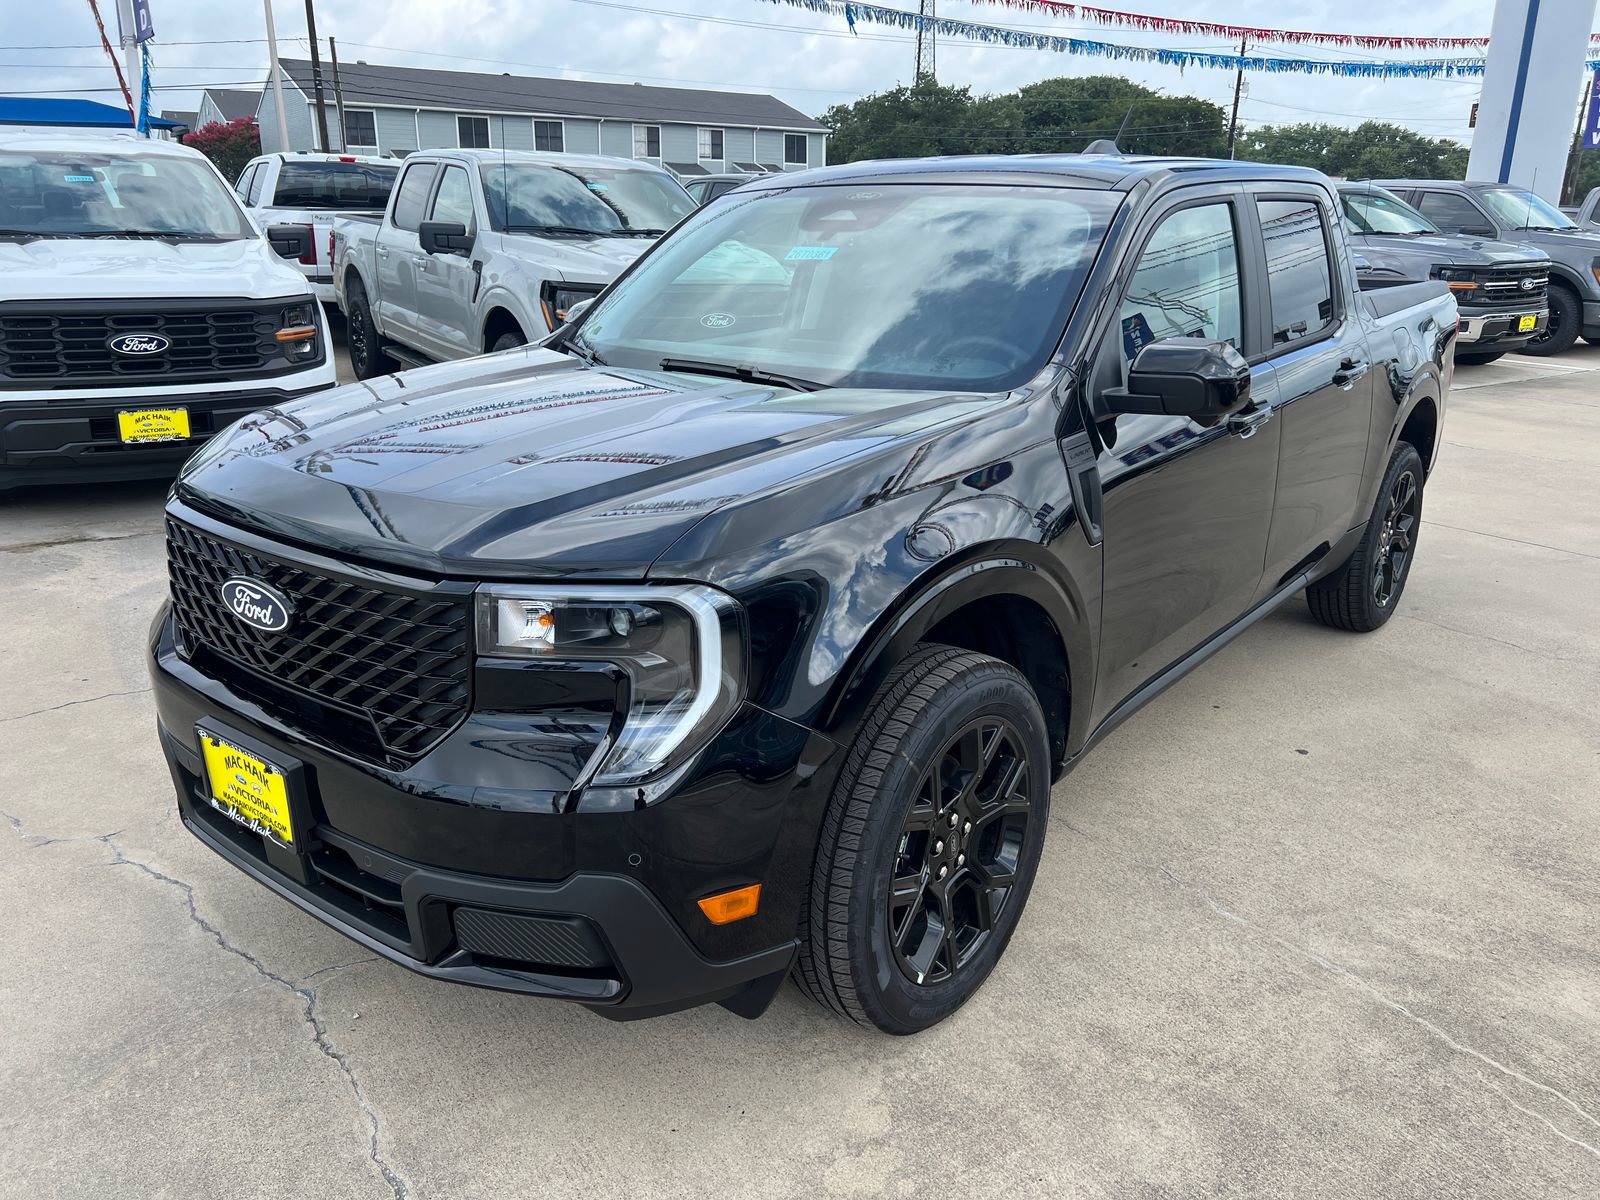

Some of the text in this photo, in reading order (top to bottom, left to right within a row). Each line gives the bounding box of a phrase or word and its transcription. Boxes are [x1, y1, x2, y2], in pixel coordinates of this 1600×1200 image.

[707, 315, 729, 326] Ford
[122, 337, 158, 351] Ford
[135, 414, 151, 425] MAC
[152, 413, 172, 422] HAIK
[233, 586, 273, 625] Ford
[224, 755, 243, 770] MAC
[243, 759, 271, 792] HAIK
[232, 784, 272, 813] VICTORIA
[227, 805, 247, 823] Mac
